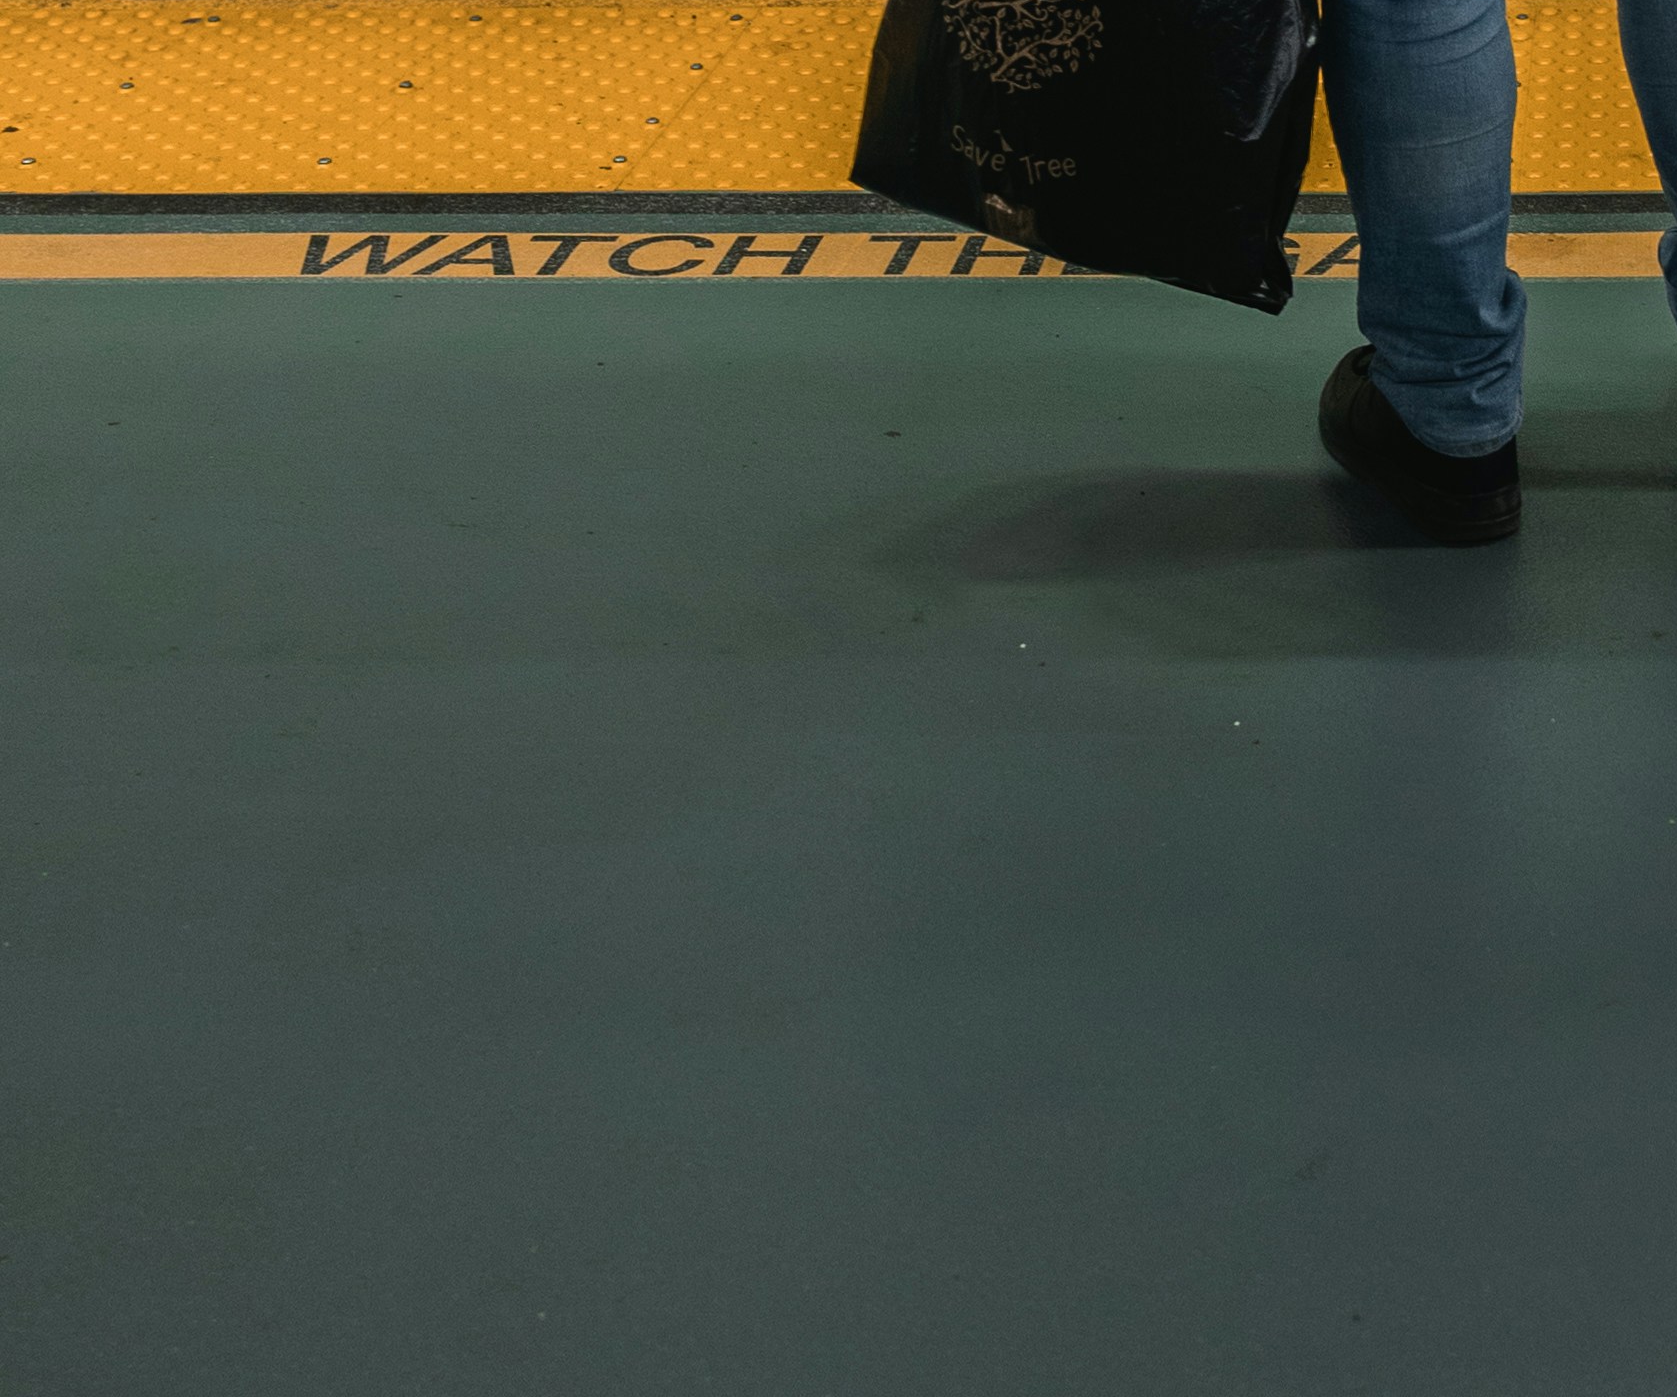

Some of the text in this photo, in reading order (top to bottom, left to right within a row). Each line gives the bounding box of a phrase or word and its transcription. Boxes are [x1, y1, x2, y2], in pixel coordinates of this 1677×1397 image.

[951, 124, 1077, 186] Save Tree
[300, 234, 1108, 276] WATCH TH
